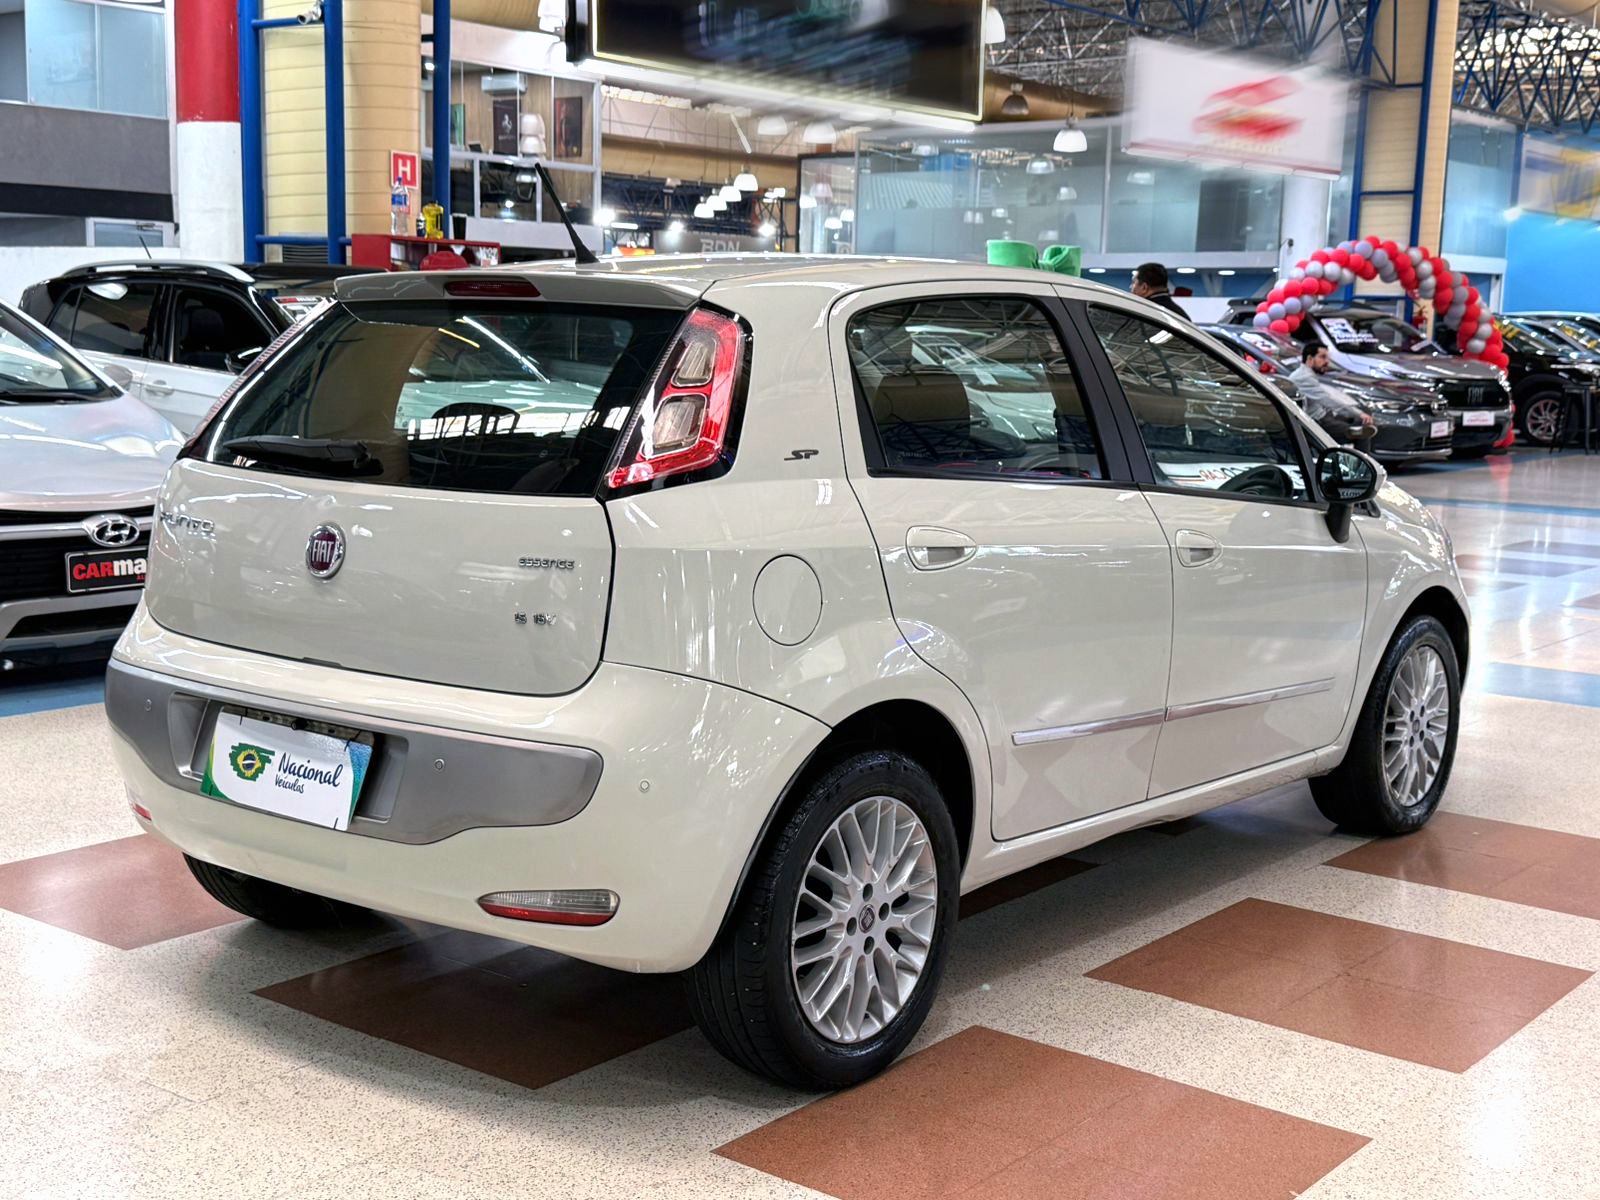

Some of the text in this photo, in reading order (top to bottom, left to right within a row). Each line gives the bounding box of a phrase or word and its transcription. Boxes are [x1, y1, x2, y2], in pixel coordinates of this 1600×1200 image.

[398, 158, 411, 181] H
[783, 449, 819, 461] SP
[312, 539, 335, 562] FIAT
[72, 558, 147, 580] CARma
[278, 752, 343, 787] Nacional
